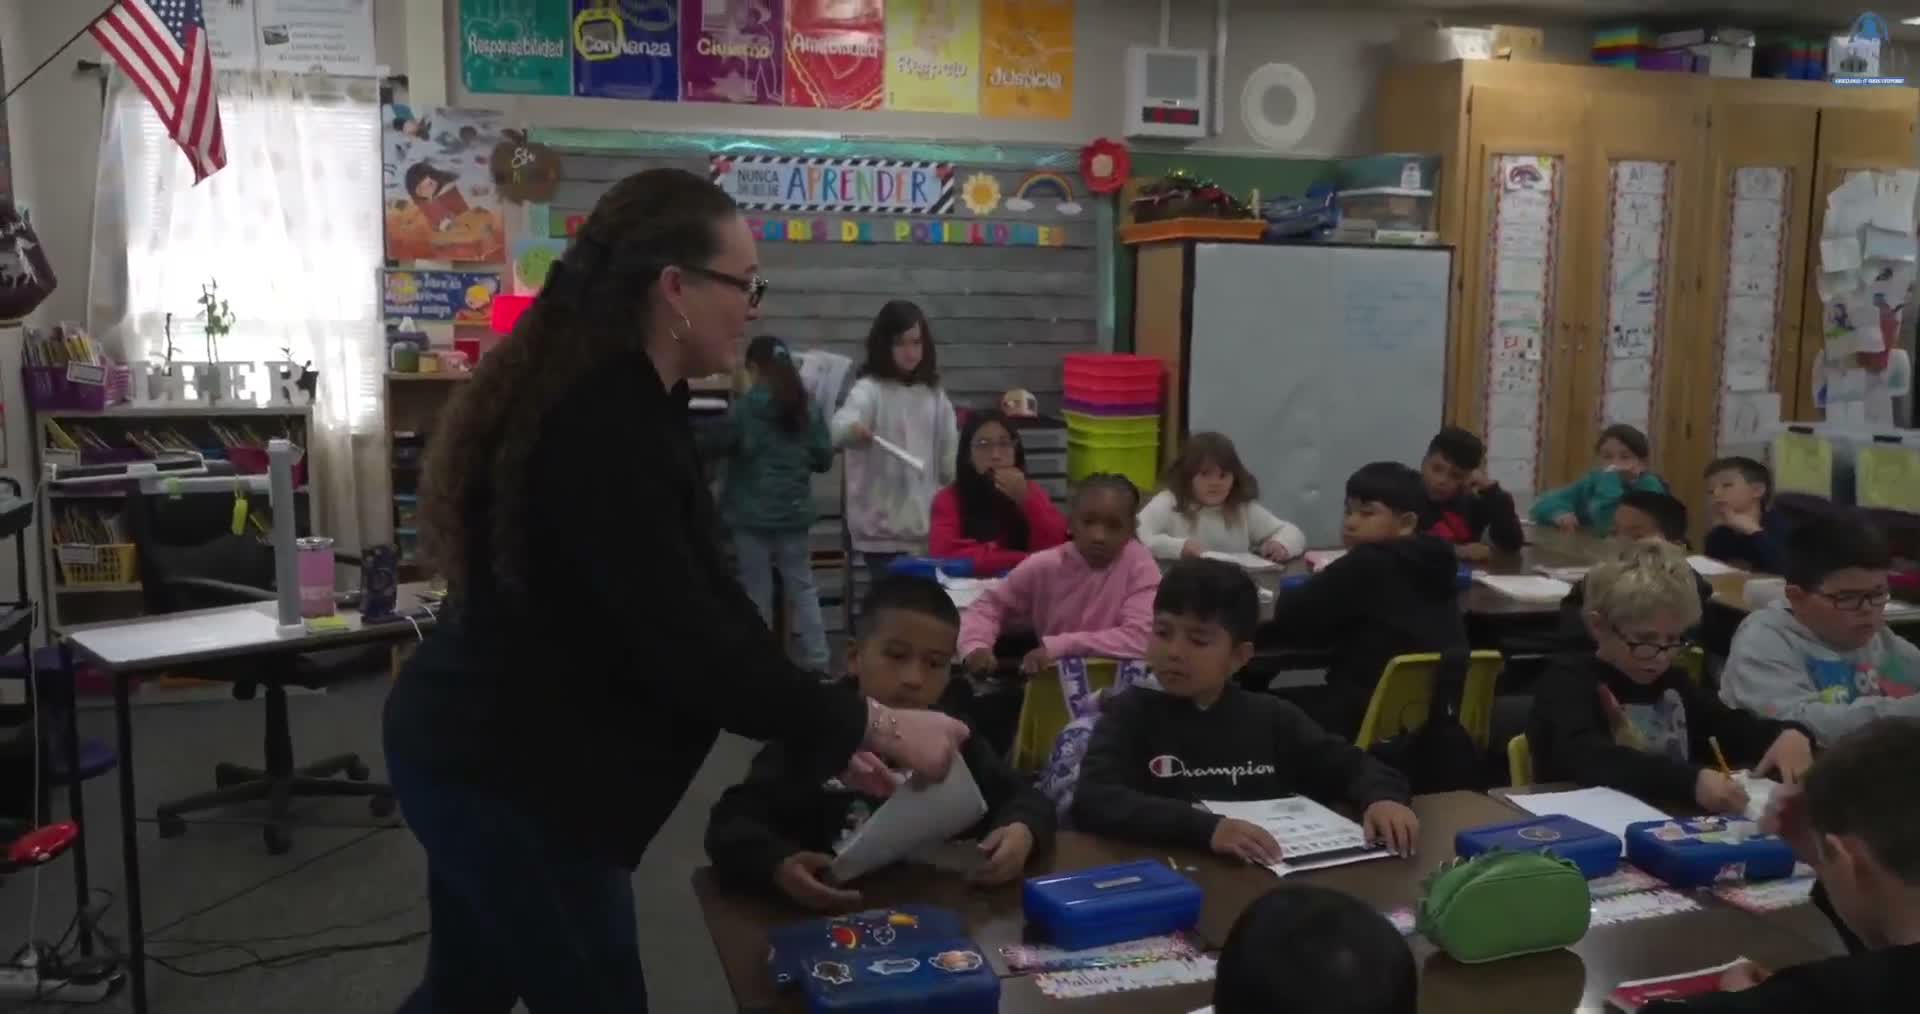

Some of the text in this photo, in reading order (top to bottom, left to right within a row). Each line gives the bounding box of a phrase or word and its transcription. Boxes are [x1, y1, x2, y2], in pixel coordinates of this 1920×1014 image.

[737, 169, 779, 183] NUNCA
[787, 166, 928, 204] APRENDER
[1149, 755, 1276, 786] Champion
